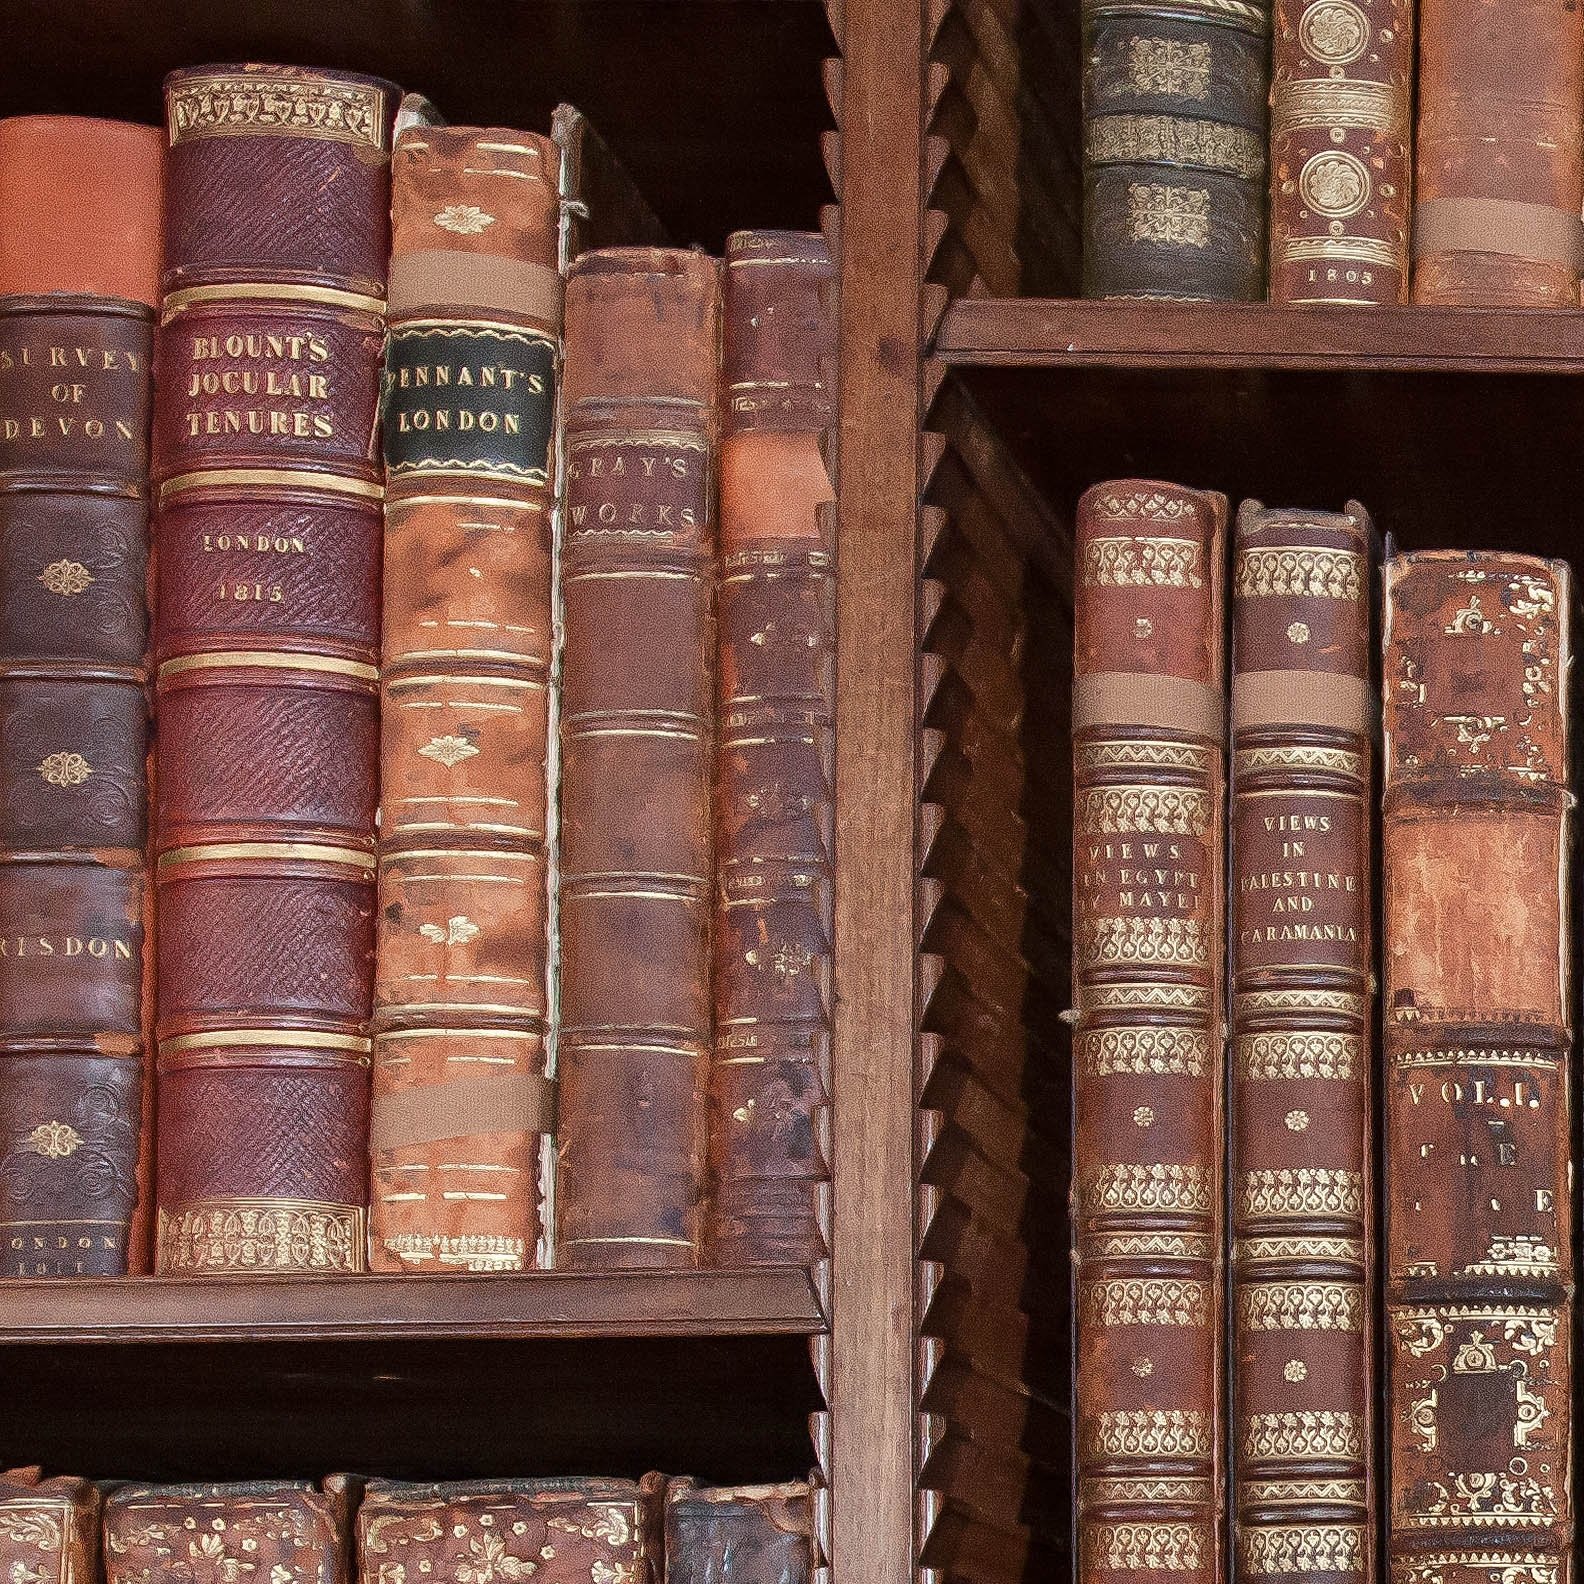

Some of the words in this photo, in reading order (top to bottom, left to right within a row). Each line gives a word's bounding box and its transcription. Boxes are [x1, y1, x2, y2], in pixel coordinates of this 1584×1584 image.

[51, 384, 84, 402] OF
[188, 372, 328, 398] JOCULAR
[4, 418, 133, 439] DEVON
[186, 412, 333, 437] TENURES
[400, 410, 520, 432] LONDON
[567, 457, 688, 478] GRAY'S
[572, 504, 695, 525] WORKS
[204, 536, 304, 552] LONDON
[220, 584, 284, 602] 1815
[1264, 816, 1330, 830] VIEWS
[1090, 844, 1181, 858] VIEWS
[1283, 842, 1304, 856] IN
[1120, 870, 1198, 886] EGYPT
[1273, 896, 1313, 912] AND
[1242, 926, 1356, 942] CARAMANIA
